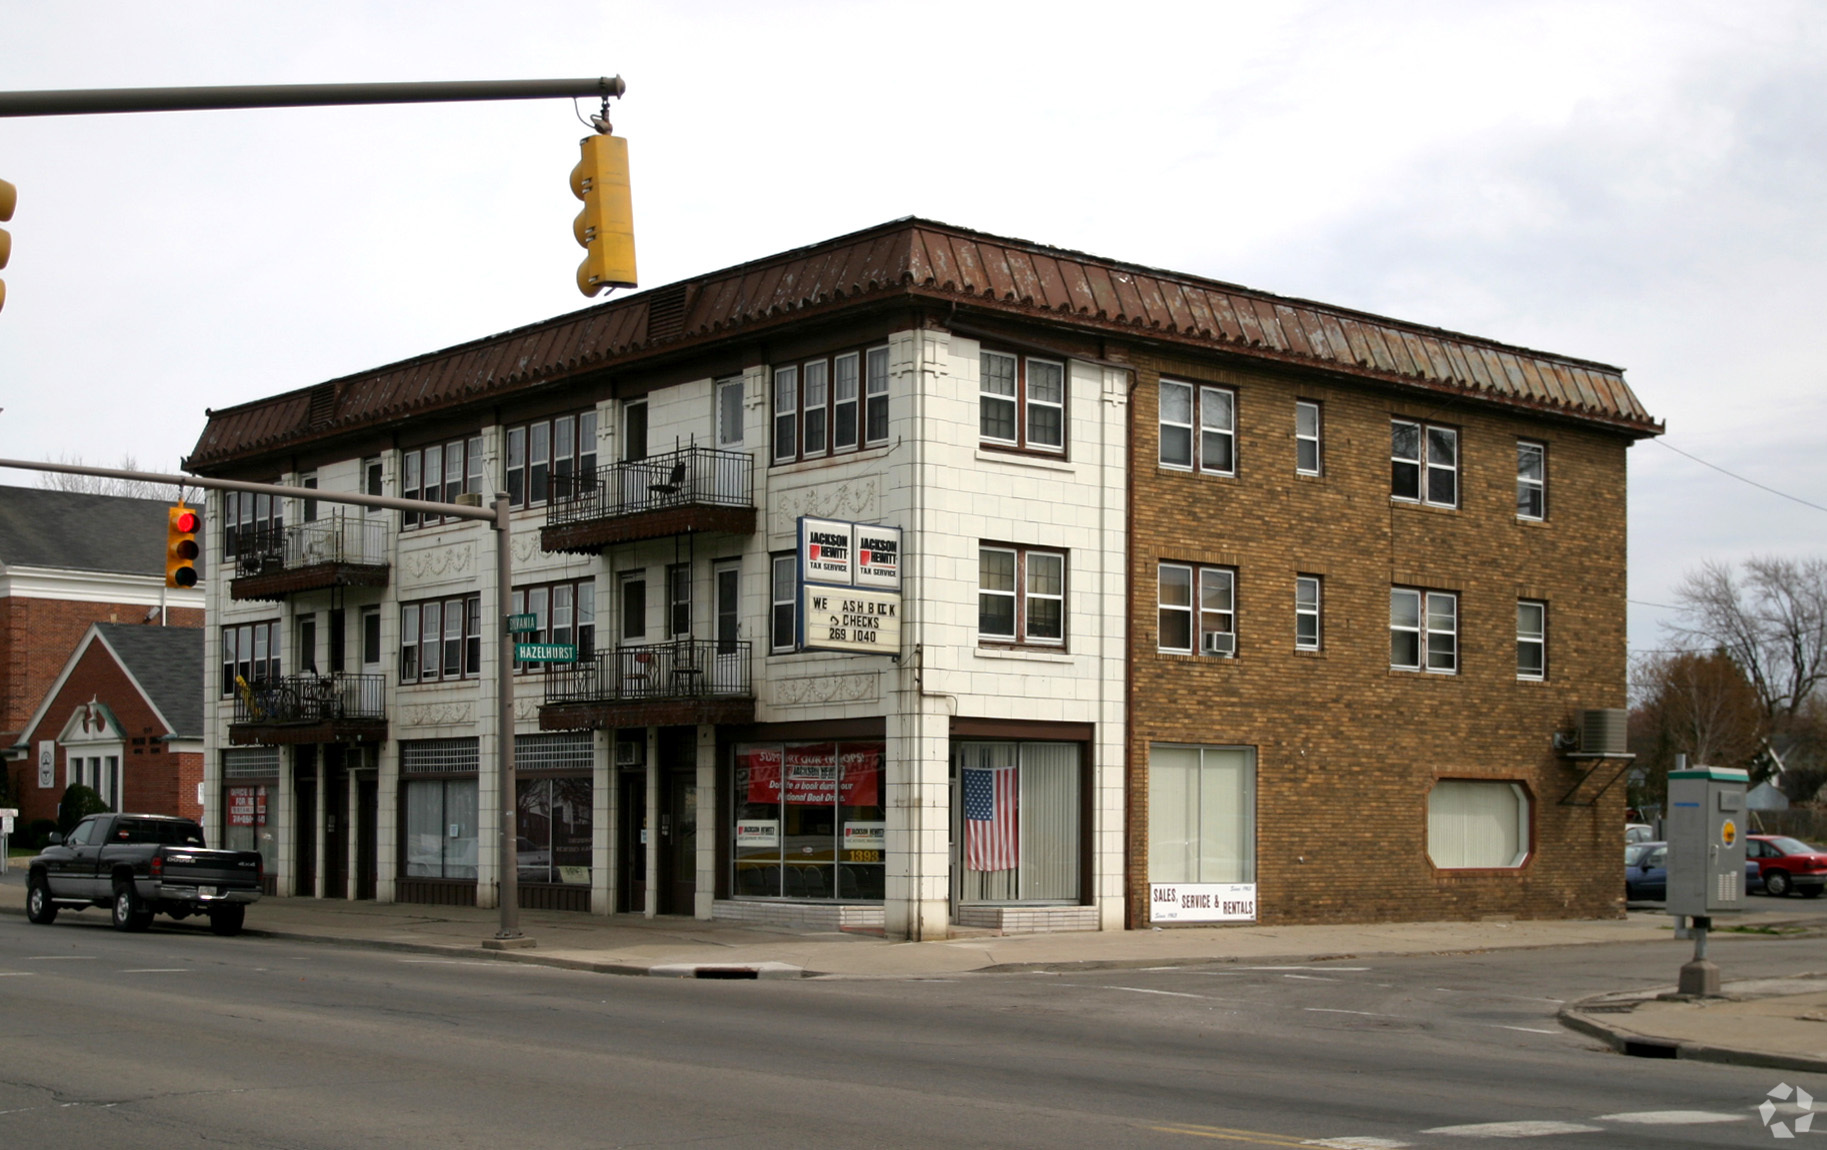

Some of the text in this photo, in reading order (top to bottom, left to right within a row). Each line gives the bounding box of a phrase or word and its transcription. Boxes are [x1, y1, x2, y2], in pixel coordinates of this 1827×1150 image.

[809, 531, 848, 547] JACKSON
[860, 537, 897, 552] JACKSON
[820, 545, 848, 559] HEWITT
[871, 550, 897, 565] HEWITT
[810, 561, 848, 573] TAX SERVICE
[860, 567, 897, 578] TAX SERVICE
[813, 597, 828, 610] WE
[842, 600, 863, 614] ASH
[843, 614, 880, 629] CHECKS
[829, 627, 876, 643] 269 1040
[520, 646, 573, 659] HAZELHURST
[760, 751, 799, 763] SUPPRT
[825, 752, 865, 764] TROPS!
[769, 780, 793, 790] Dote
[801, 781, 818, 790] book
[819, 781, 837, 791] durin
[777, 792, 846, 802] Ntional Book Drie.
[850, 851, 880, 862] 1393
[1153, 888, 1254, 915] SALES, SERVICE & RENTALS
